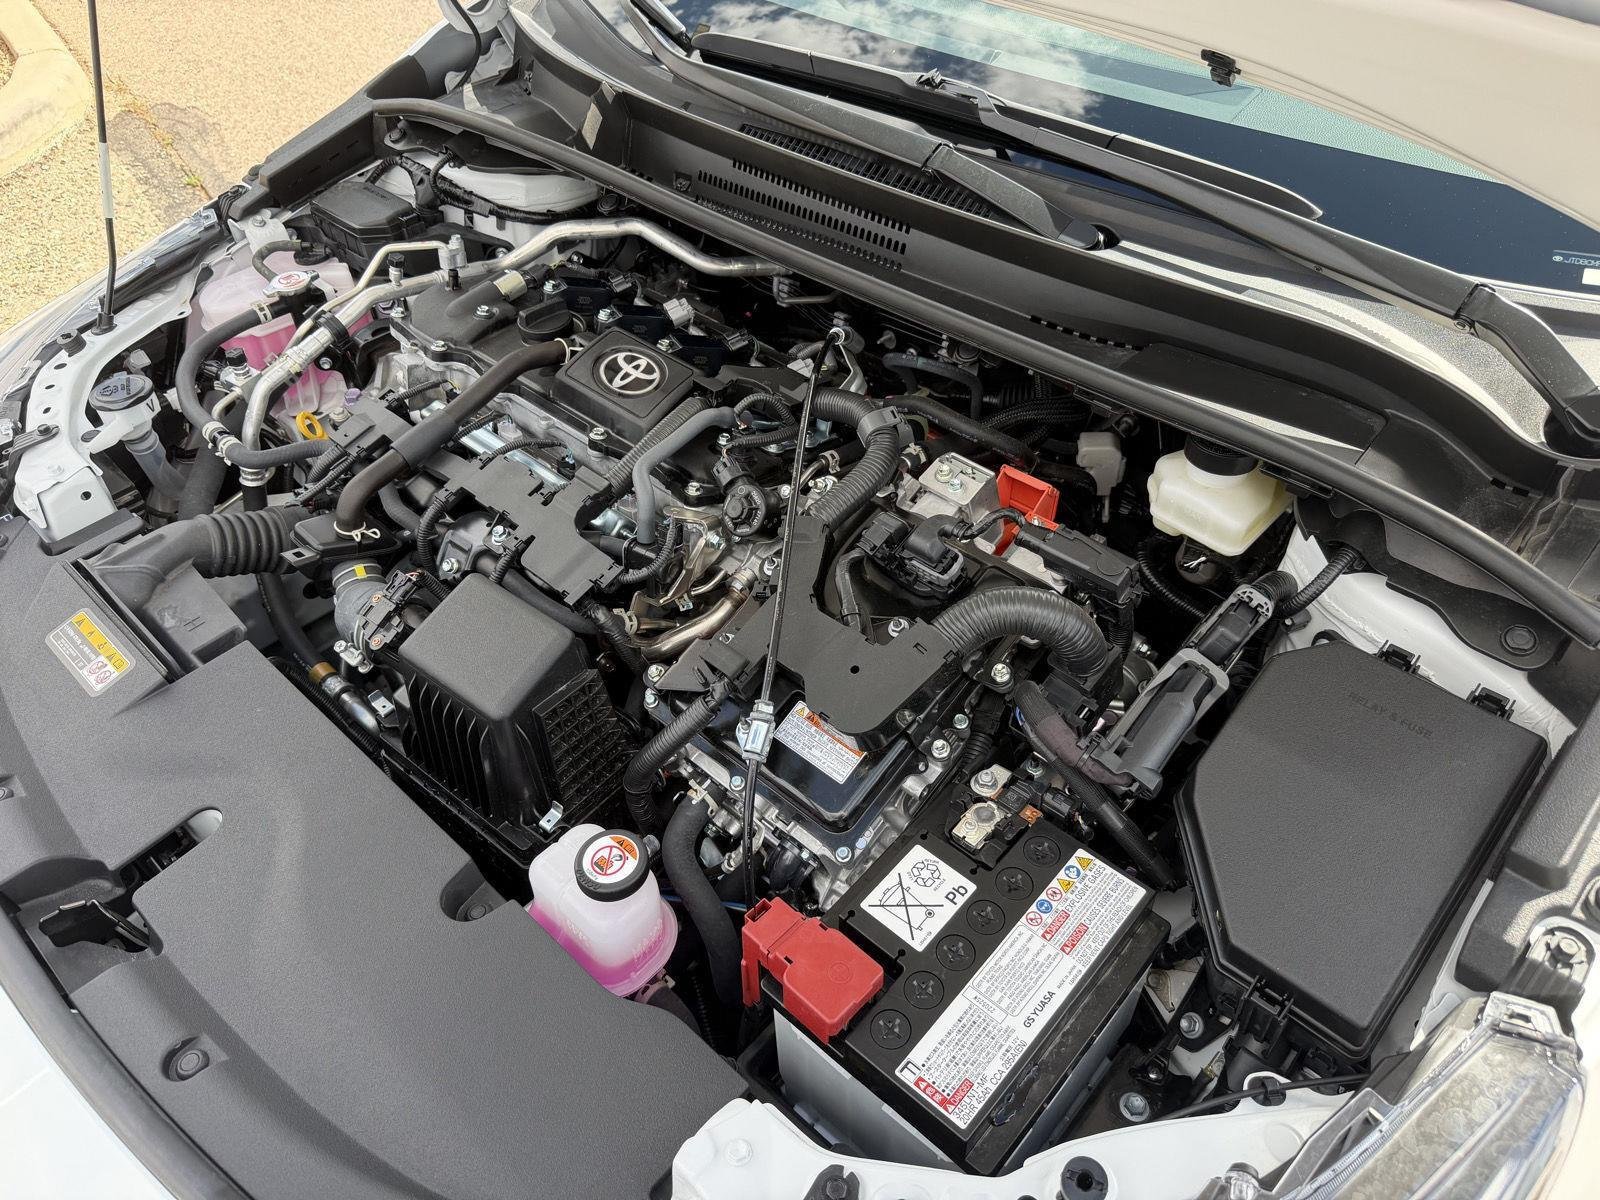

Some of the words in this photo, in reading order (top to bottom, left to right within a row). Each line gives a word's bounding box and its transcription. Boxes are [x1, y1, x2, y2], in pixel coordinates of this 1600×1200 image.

[945, 884, 968, 905] Pb
[1046, 910, 1068, 934] DANGER
[1064, 882, 1091, 912] EXPLOSIVE
[1087, 864, 1106, 884] GASES
[1065, 923, 1087, 948] POISON
[1022, 1014, 1036, 1029] GS
[1031, 989, 1056, 1017] YUASA
[950, 1079, 972, 1105] DANGER
[952, 1073, 990, 1119] 345LN1-MF
[959, 1103, 978, 1125] 20HR
[974, 1085, 992, 1105] 45Ah
[989, 1067, 1006, 1086] CCA
[1001, 1038, 1028, 1070] 295A(EN)
